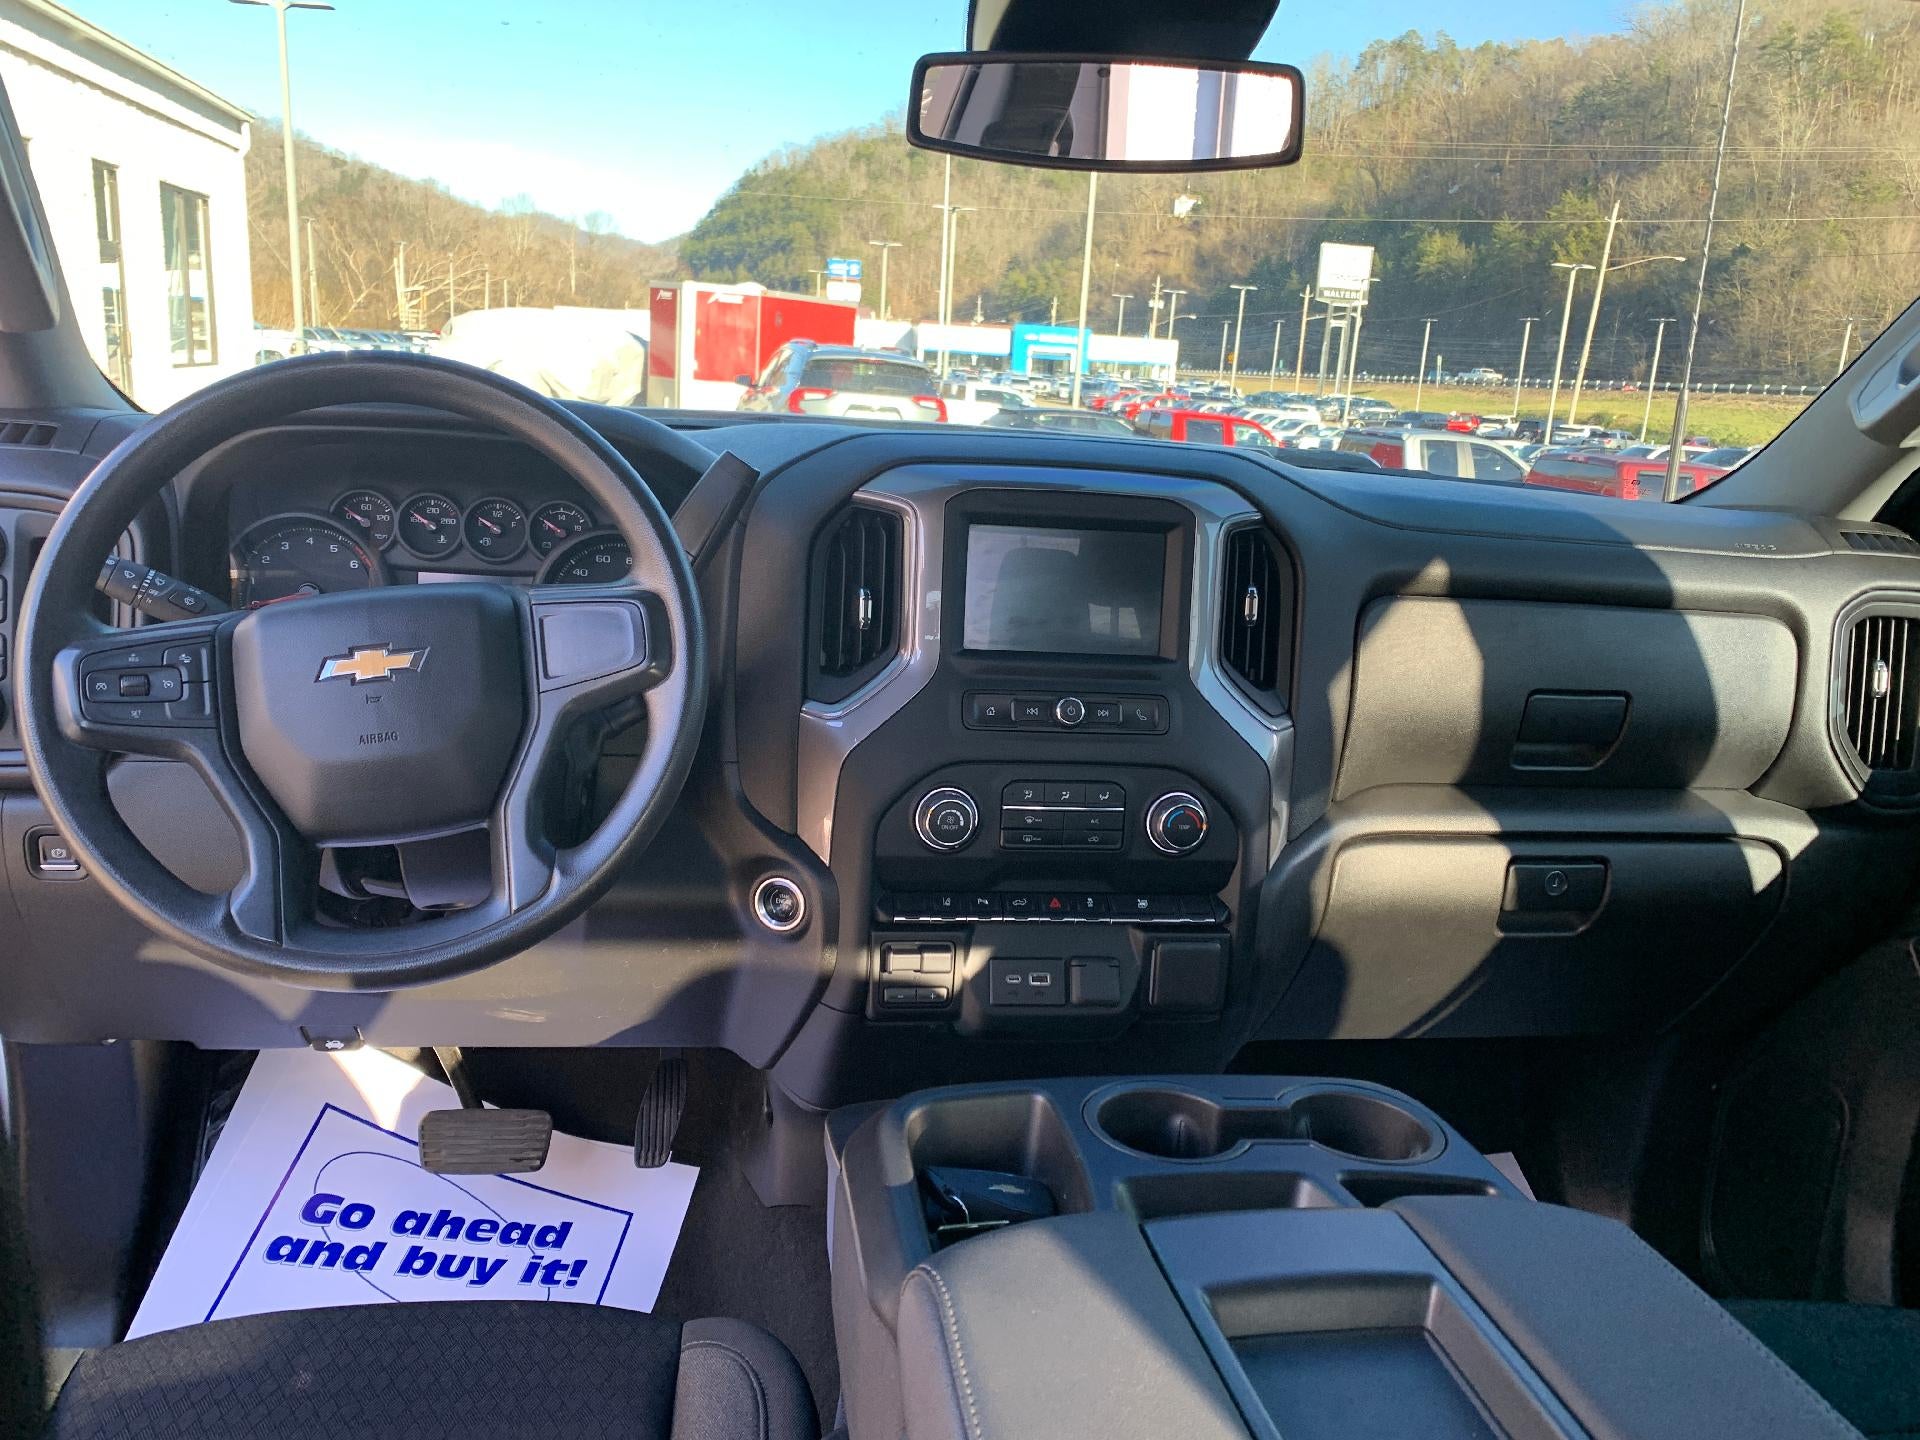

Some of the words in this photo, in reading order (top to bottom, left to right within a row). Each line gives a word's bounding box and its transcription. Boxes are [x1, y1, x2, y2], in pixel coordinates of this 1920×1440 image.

[361, 503, 372, 511] 60
[305, 537, 314, 545] 4
[281, 542, 289, 550] 3
[330, 544, 338, 553] 5
[261, 555, 271, 564] 2
[595, 555, 611, 563] 60
[350, 560, 359, 569] 6
[573, 568, 588, 577] 40
[359, 731, 399, 745] AIRBAG
[300, 1192, 376, 1230] Go
[391, 1209, 574, 1249] ahead
[264, 1235, 388, 1273] and
[395, 1245, 508, 1288] buy
[518, 1255, 588, 1288] it!
